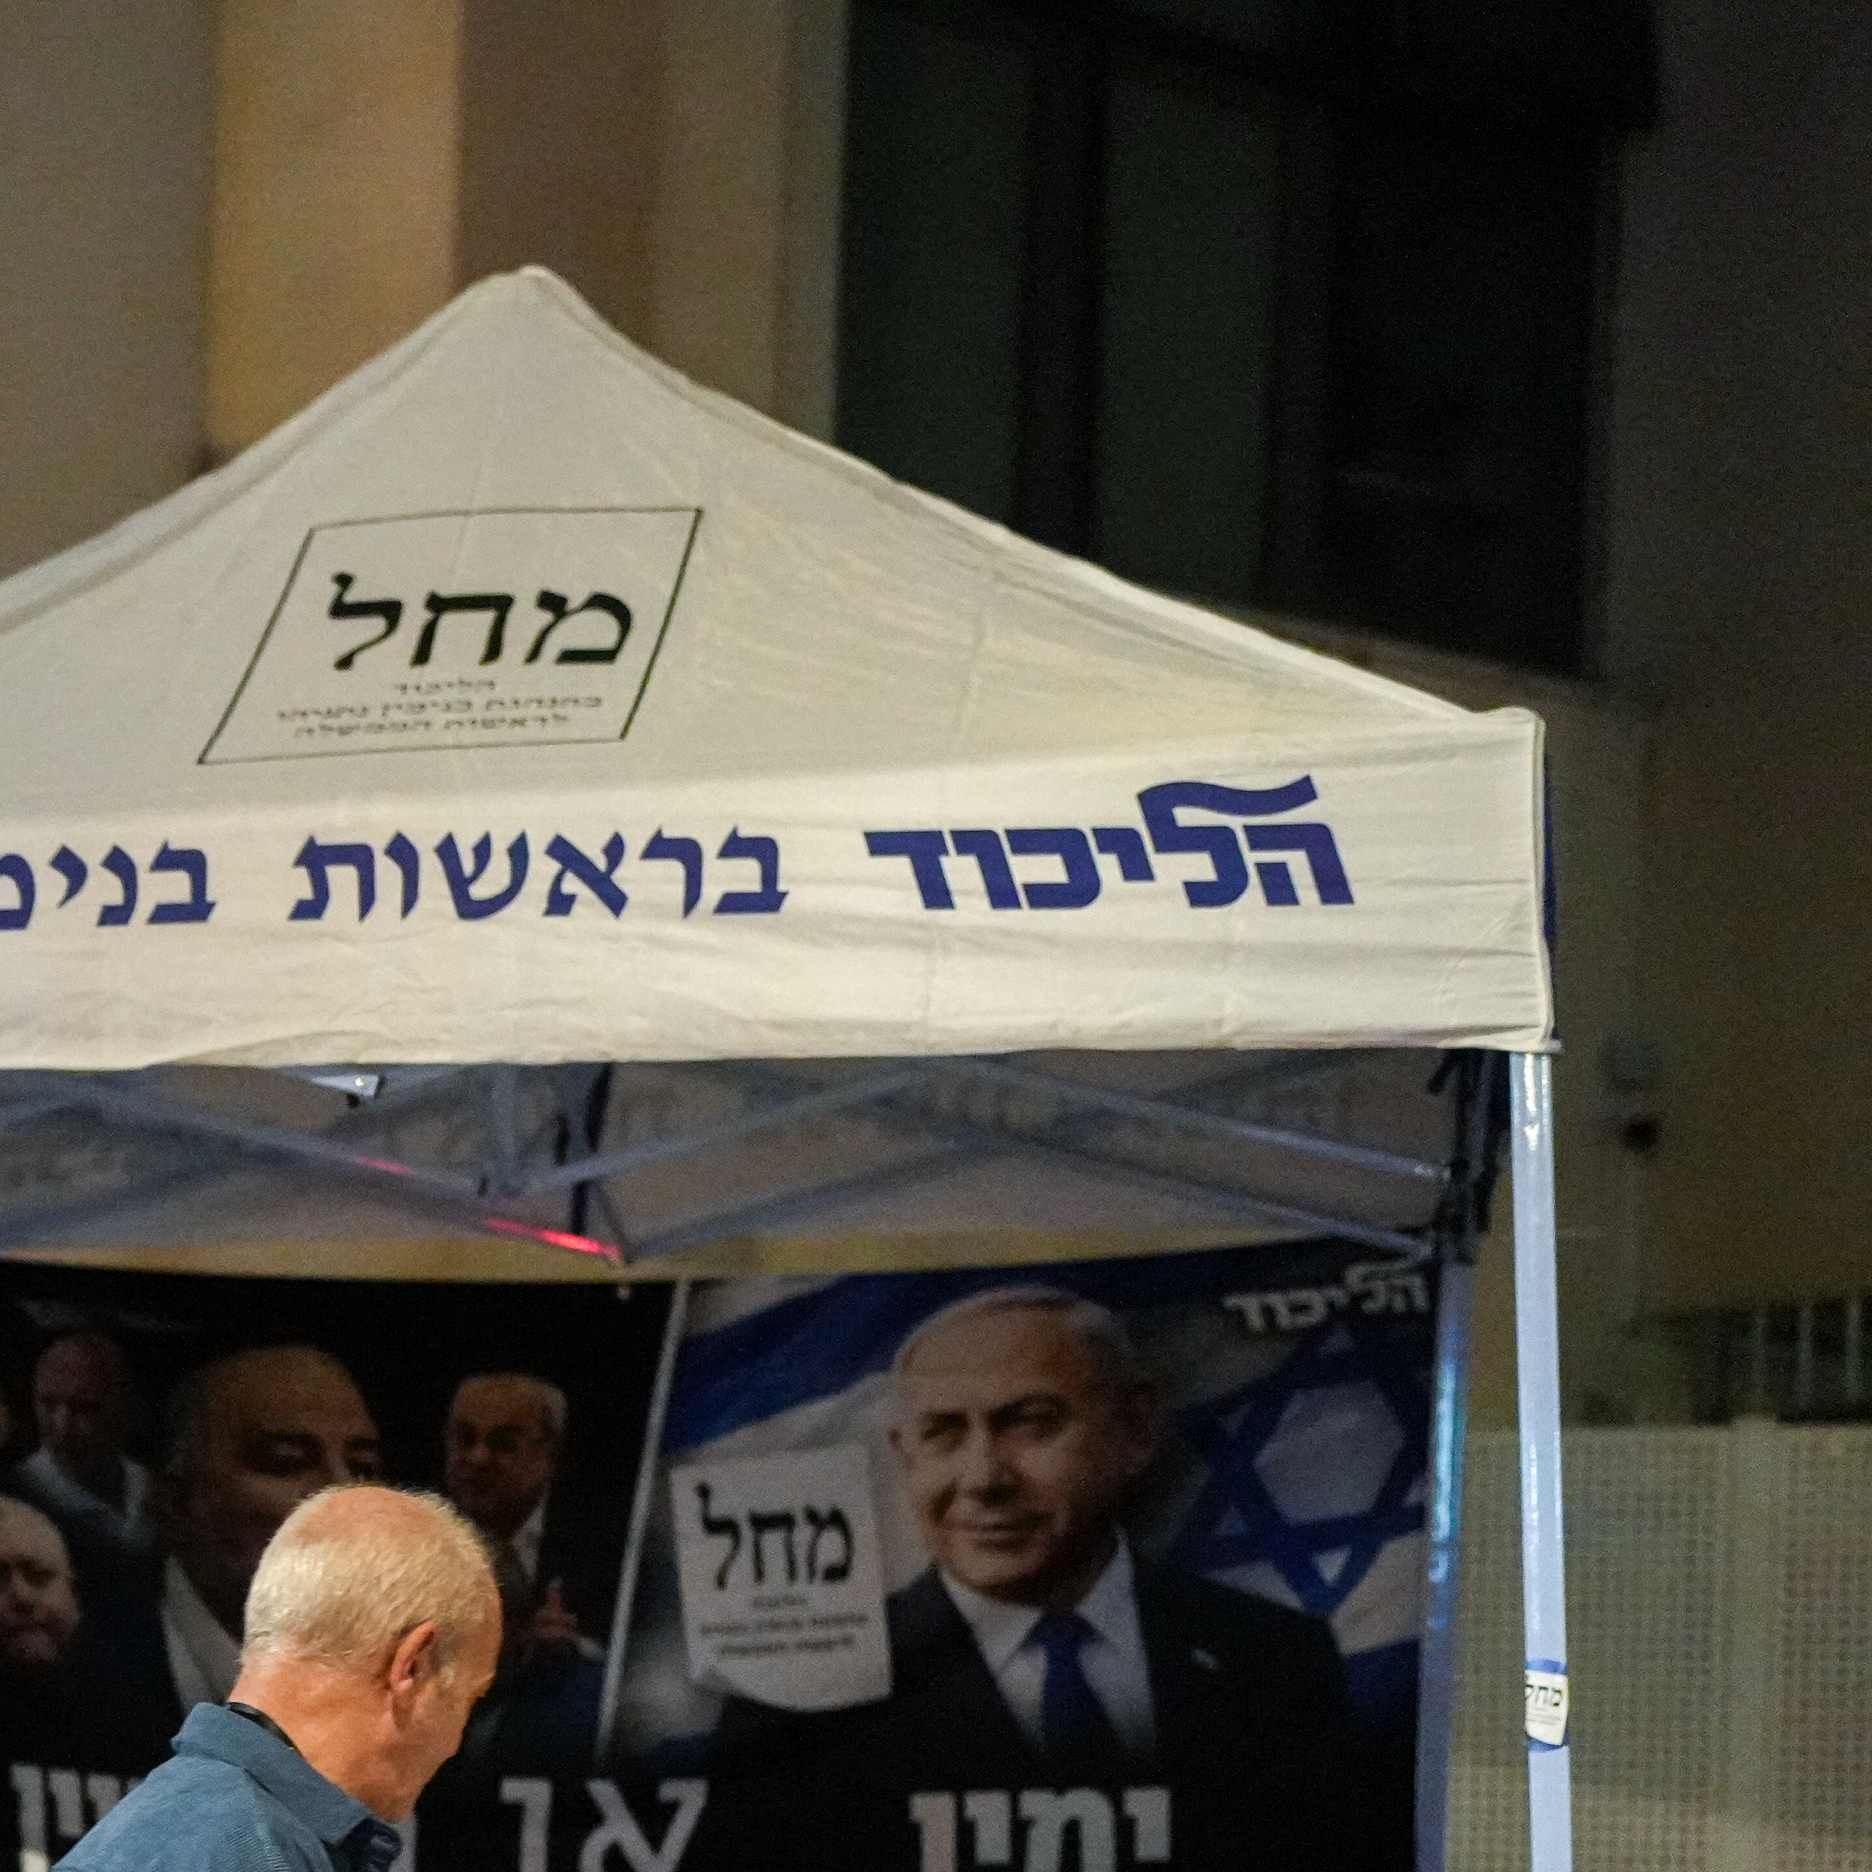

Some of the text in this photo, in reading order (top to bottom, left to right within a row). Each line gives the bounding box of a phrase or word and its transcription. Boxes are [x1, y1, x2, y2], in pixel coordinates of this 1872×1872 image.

[329, 571, 633, 671] מחל
[287, 825, 789, 923] בראשות
[864, 774, 1354, 910] הליכוד
[1224, 1260, 1430, 1333] הליכוד
[695, 1481, 852, 1589] מחל
